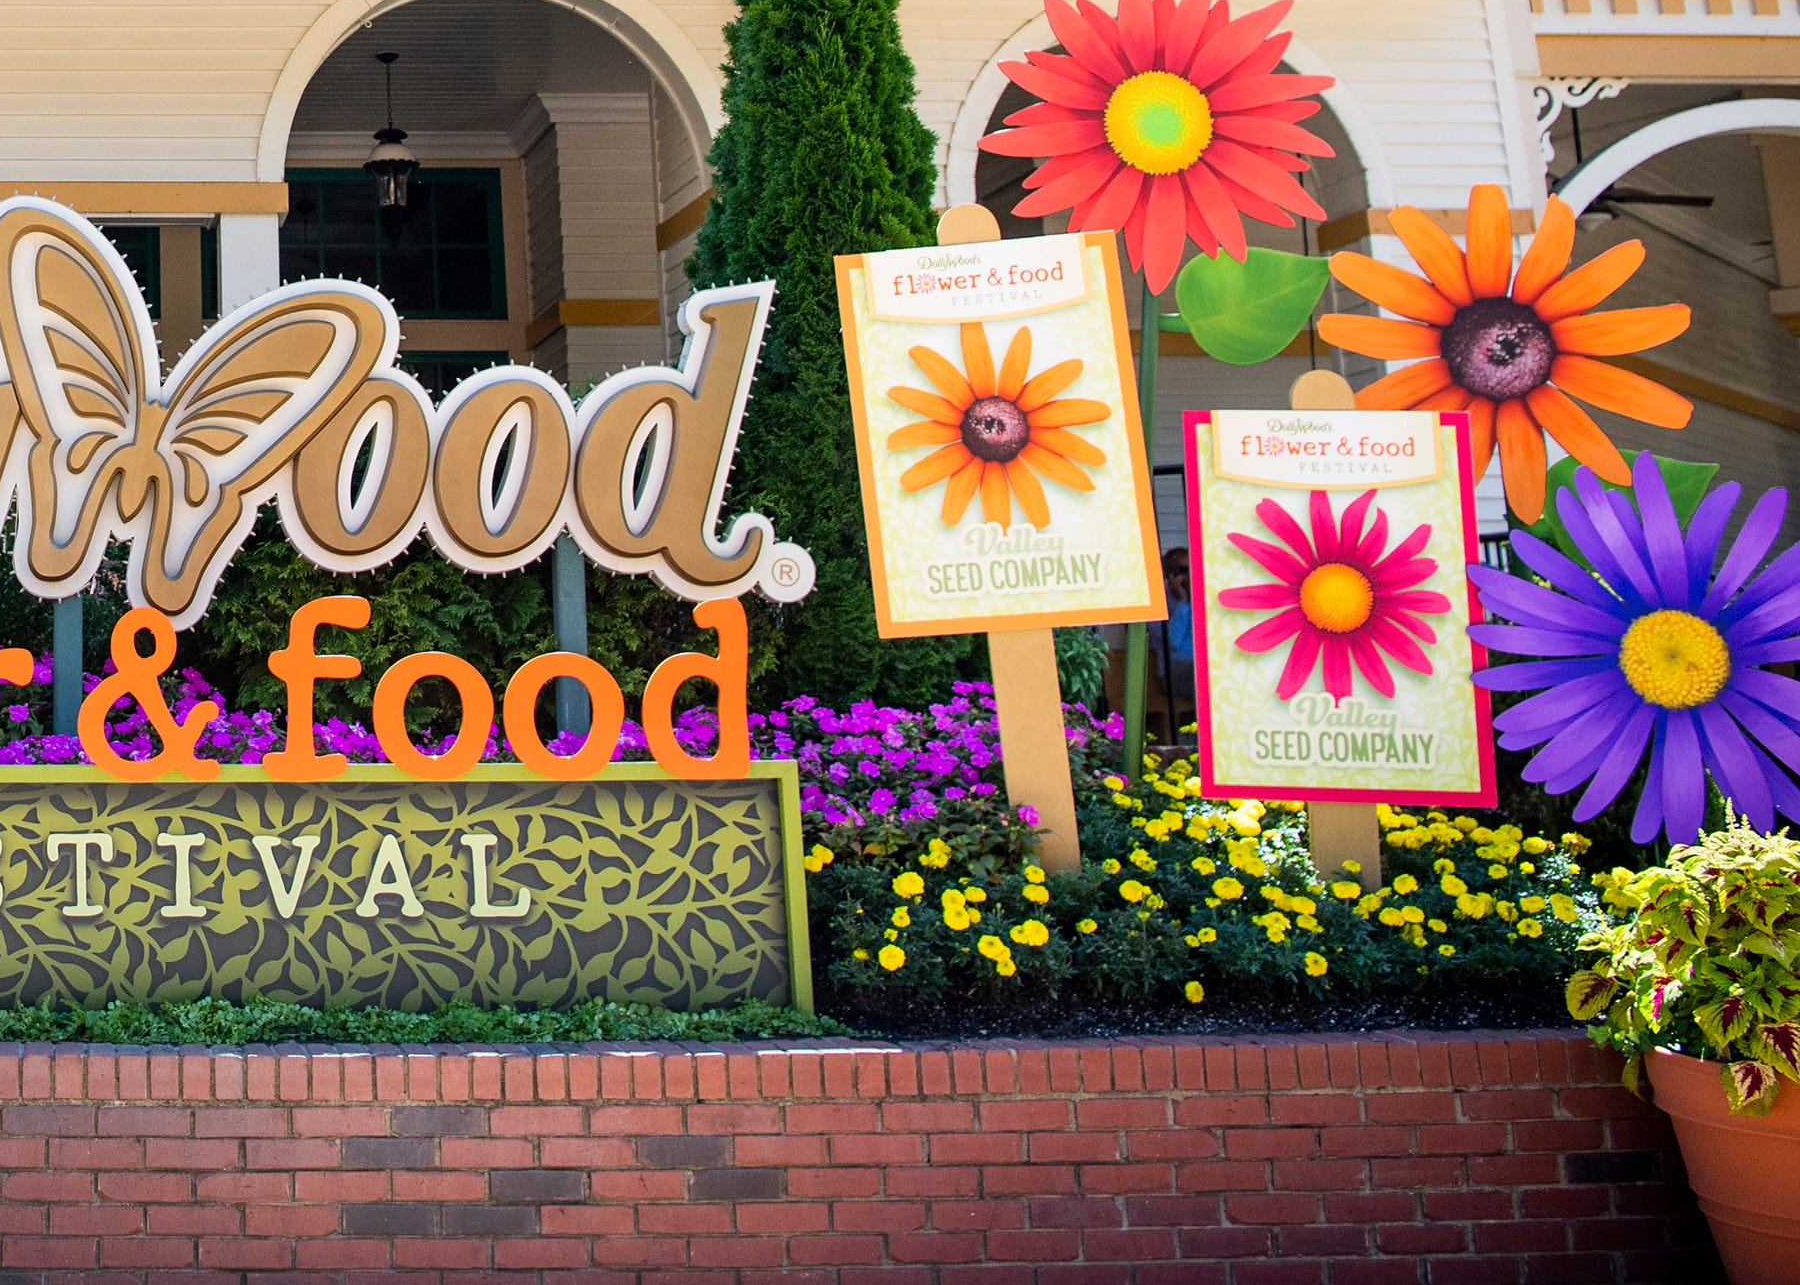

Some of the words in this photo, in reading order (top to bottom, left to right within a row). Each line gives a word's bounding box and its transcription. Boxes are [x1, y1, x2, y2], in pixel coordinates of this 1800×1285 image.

[987, 268, 1003, 286] &
[1009, 261, 1064, 284] food
[952, 289, 1042, 306] FESTIVAL
[1337, 438, 1353, 456] &
[1359, 437, 1415, 456] food
[1299, 462, 1392, 473] FESTIVAL
[966, 526, 1064, 560] Valley
[928, 562, 983, 594] SEED
[990, 553, 1102, 590] COMPANY
[76, 608, 223, 783] &
[262, 596, 751, 782] food
[1295, 696, 1399, 738] Valley
[1256, 730, 1311, 761] SEED
[1319, 731, 1434, 764] COMPANY
